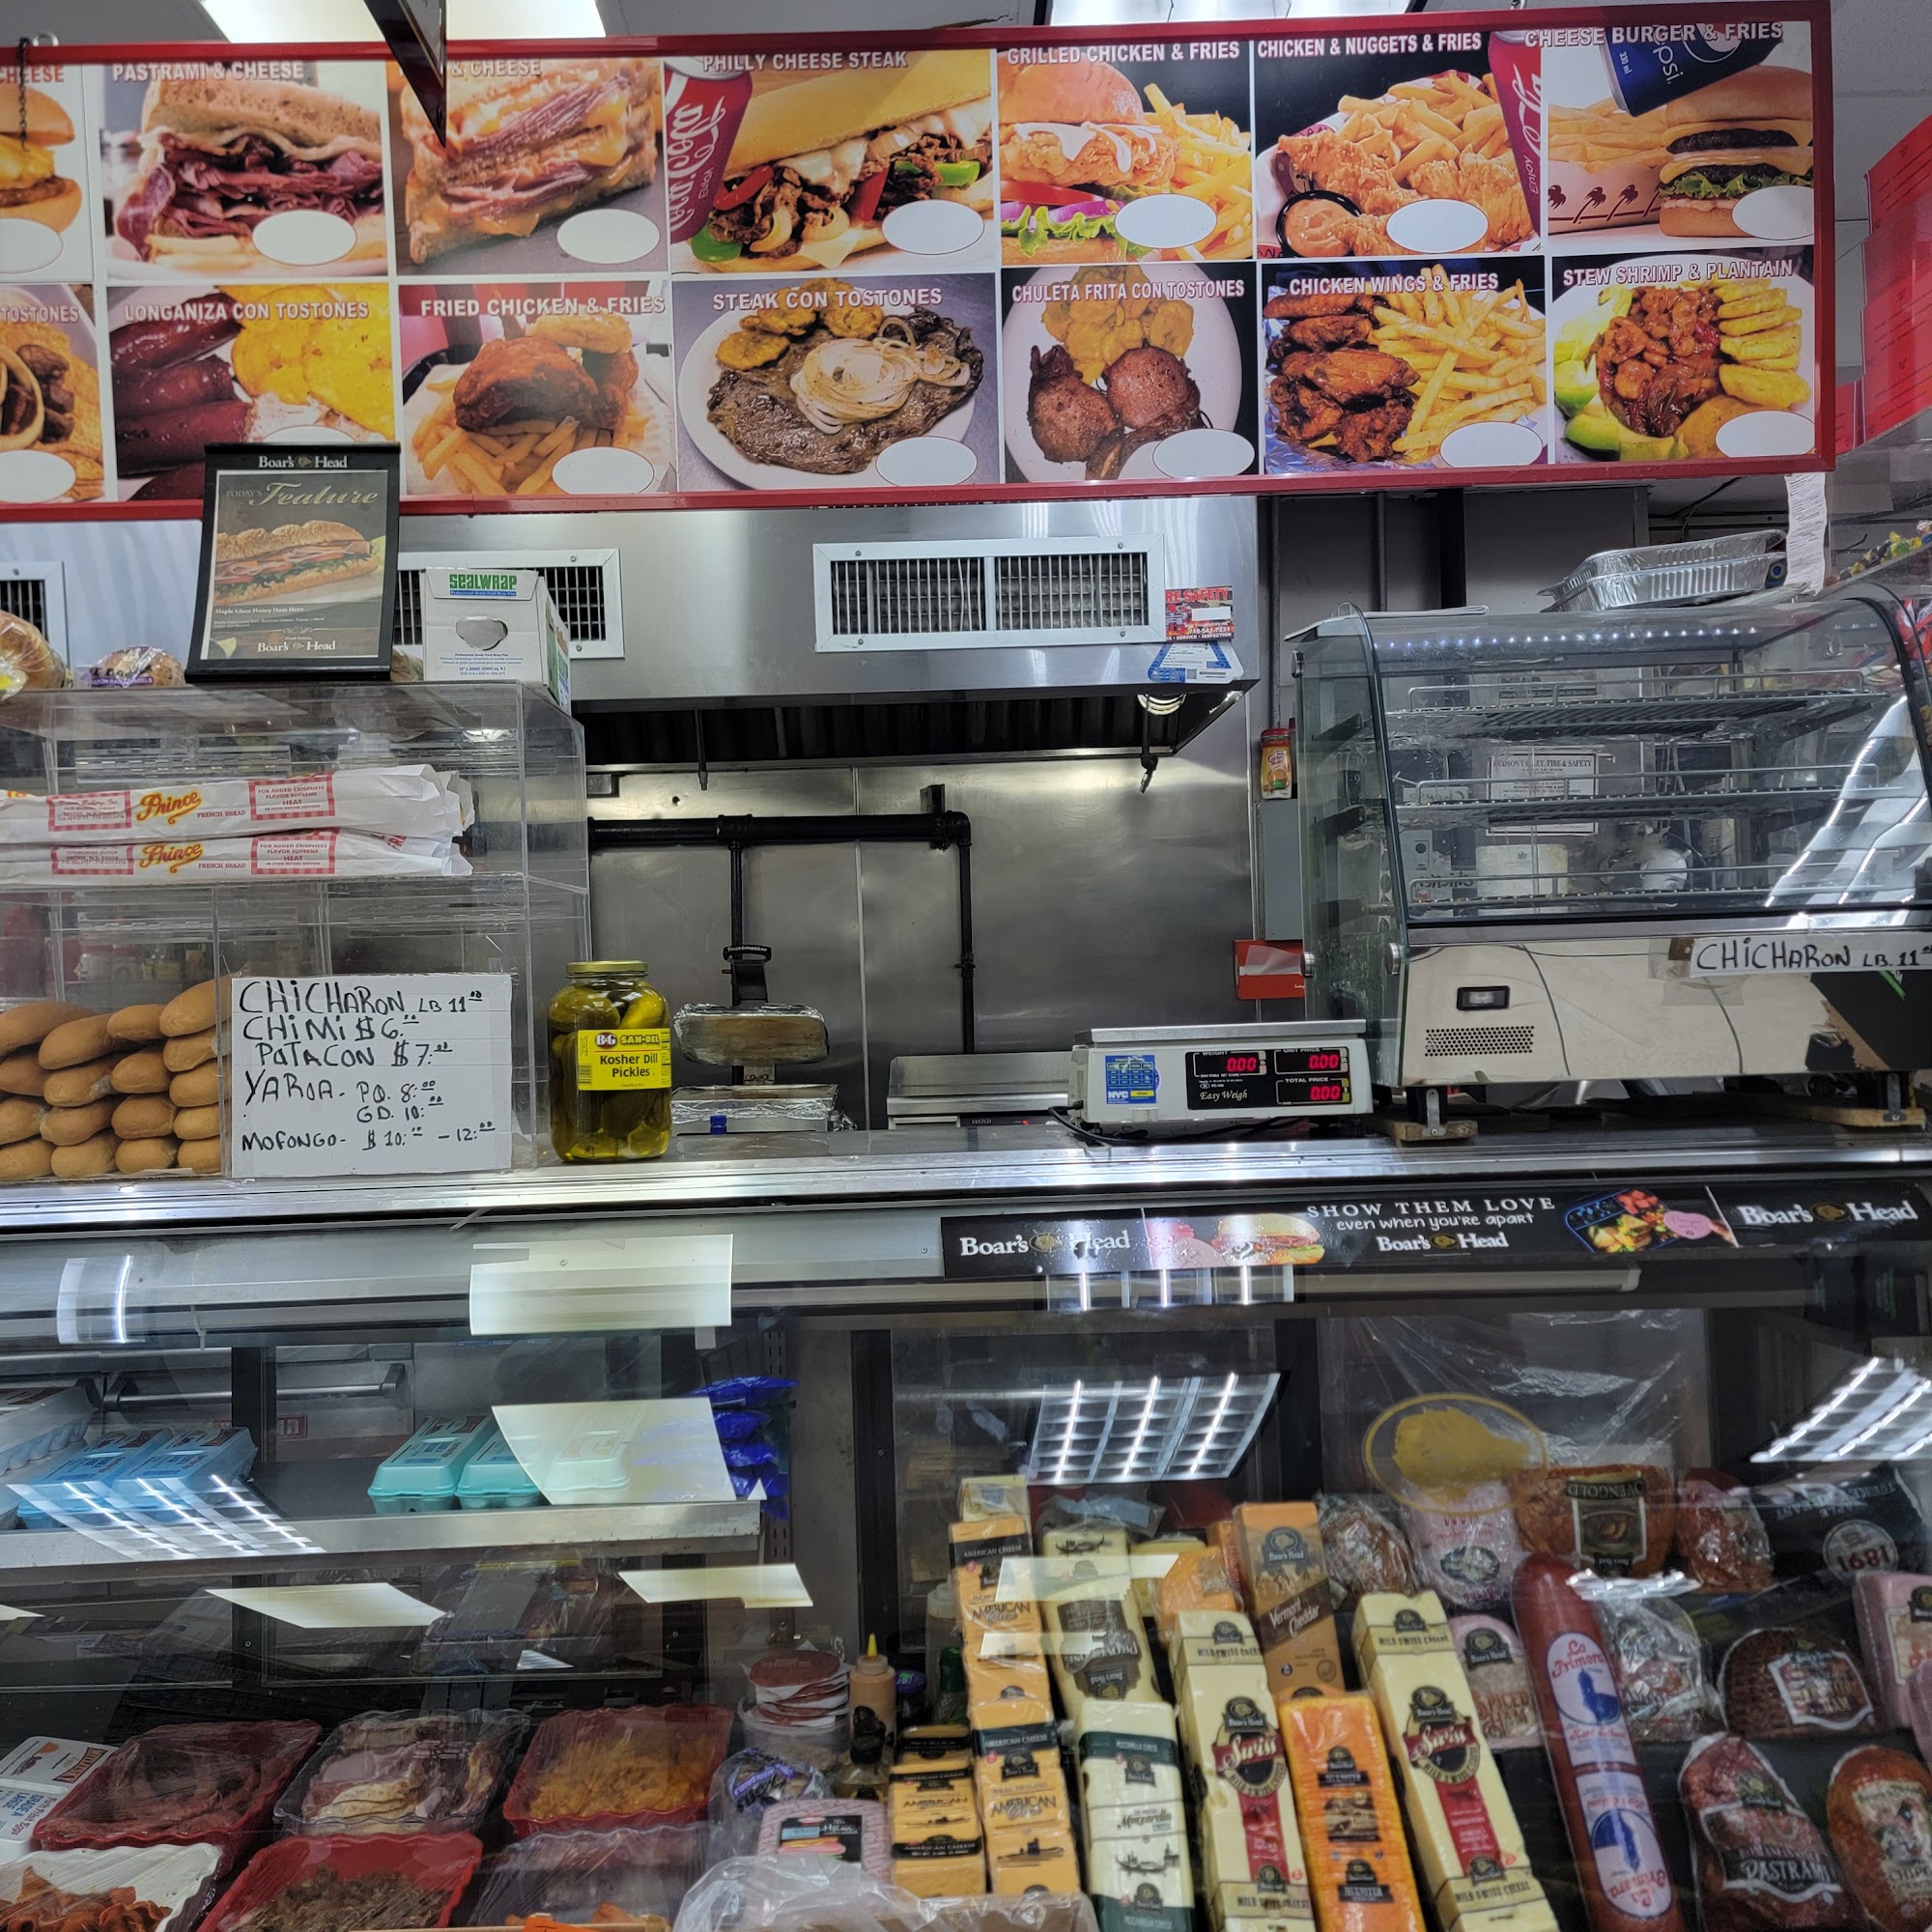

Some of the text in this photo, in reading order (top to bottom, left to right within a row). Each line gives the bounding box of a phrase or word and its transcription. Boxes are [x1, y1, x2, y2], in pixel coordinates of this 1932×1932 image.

[1257, 32, 1482, 60] CHICKEN & NUGGETS & FRIES
[1523, 21, 1784, 48] CHEESE BURGER & FRIES
[703, 50, 909, 71] PHILLY CHEESE STEAK
[1008, 41, 1240, 66] GRILLED CHICKEN & FRIES
[112, 60, 305, 82] PASTRAMI & CHEESE
[451, 58, 543, 77] & CHEESE
[1289, 271, 1499, 296] CHICKEN WINGS & FRIES
[1563, 259, 1794, 287] STEW SHRIMP & PLANTAIN
[713, 288, 943, 312] STEAK CON TOSTONES
[1011, 279, 1245, 303] CHULETA FRITA CON TOSTONES
[0, 305, 80, 324] TOSTONES
[126, 300, 369, 323] LONGANIZA CON TOSTONES
[420, 295, 667, 318] FRIED CHICKEN & FRIES
[258, 455, 348, 469] Boar's Head
[249, 482, 379, 506] Feature
[1183, 587, 1230, 603] SAFETY
[257, 639, 336, 653] Boar's Head
[418, 997, 442, 1013] LB
[600, 1052, 659, 1065] Kosher Dill
[611, 1066, 651, 1078] Pickles
[1107, 1090, 1129, 1099] NYC
[1199, 1089, 1248, 1102] Easy Weigh
[1307, 1196, 1556, 1219] SHOW THEM LOVE
[1739, 1201, 1919, 1226] Boar's Head
[1336, 1217, 1377, 1232] even
[1378, 1215, 1426, 1230] when
[959, 1229, 1131, 1257] Boar's Head
[1376, 1231, 1510, 1253] Boar's Head
[1268, 1597, 1304, 1630] Vermont
[1288, 1605, 1321, 1638] Cheddar
[1222, 1734, 1278, 1771] Swiss
[1413, 1724, 1467, 1762] Swiss
[990, 1795, 1057, 1817] AMERICAN
